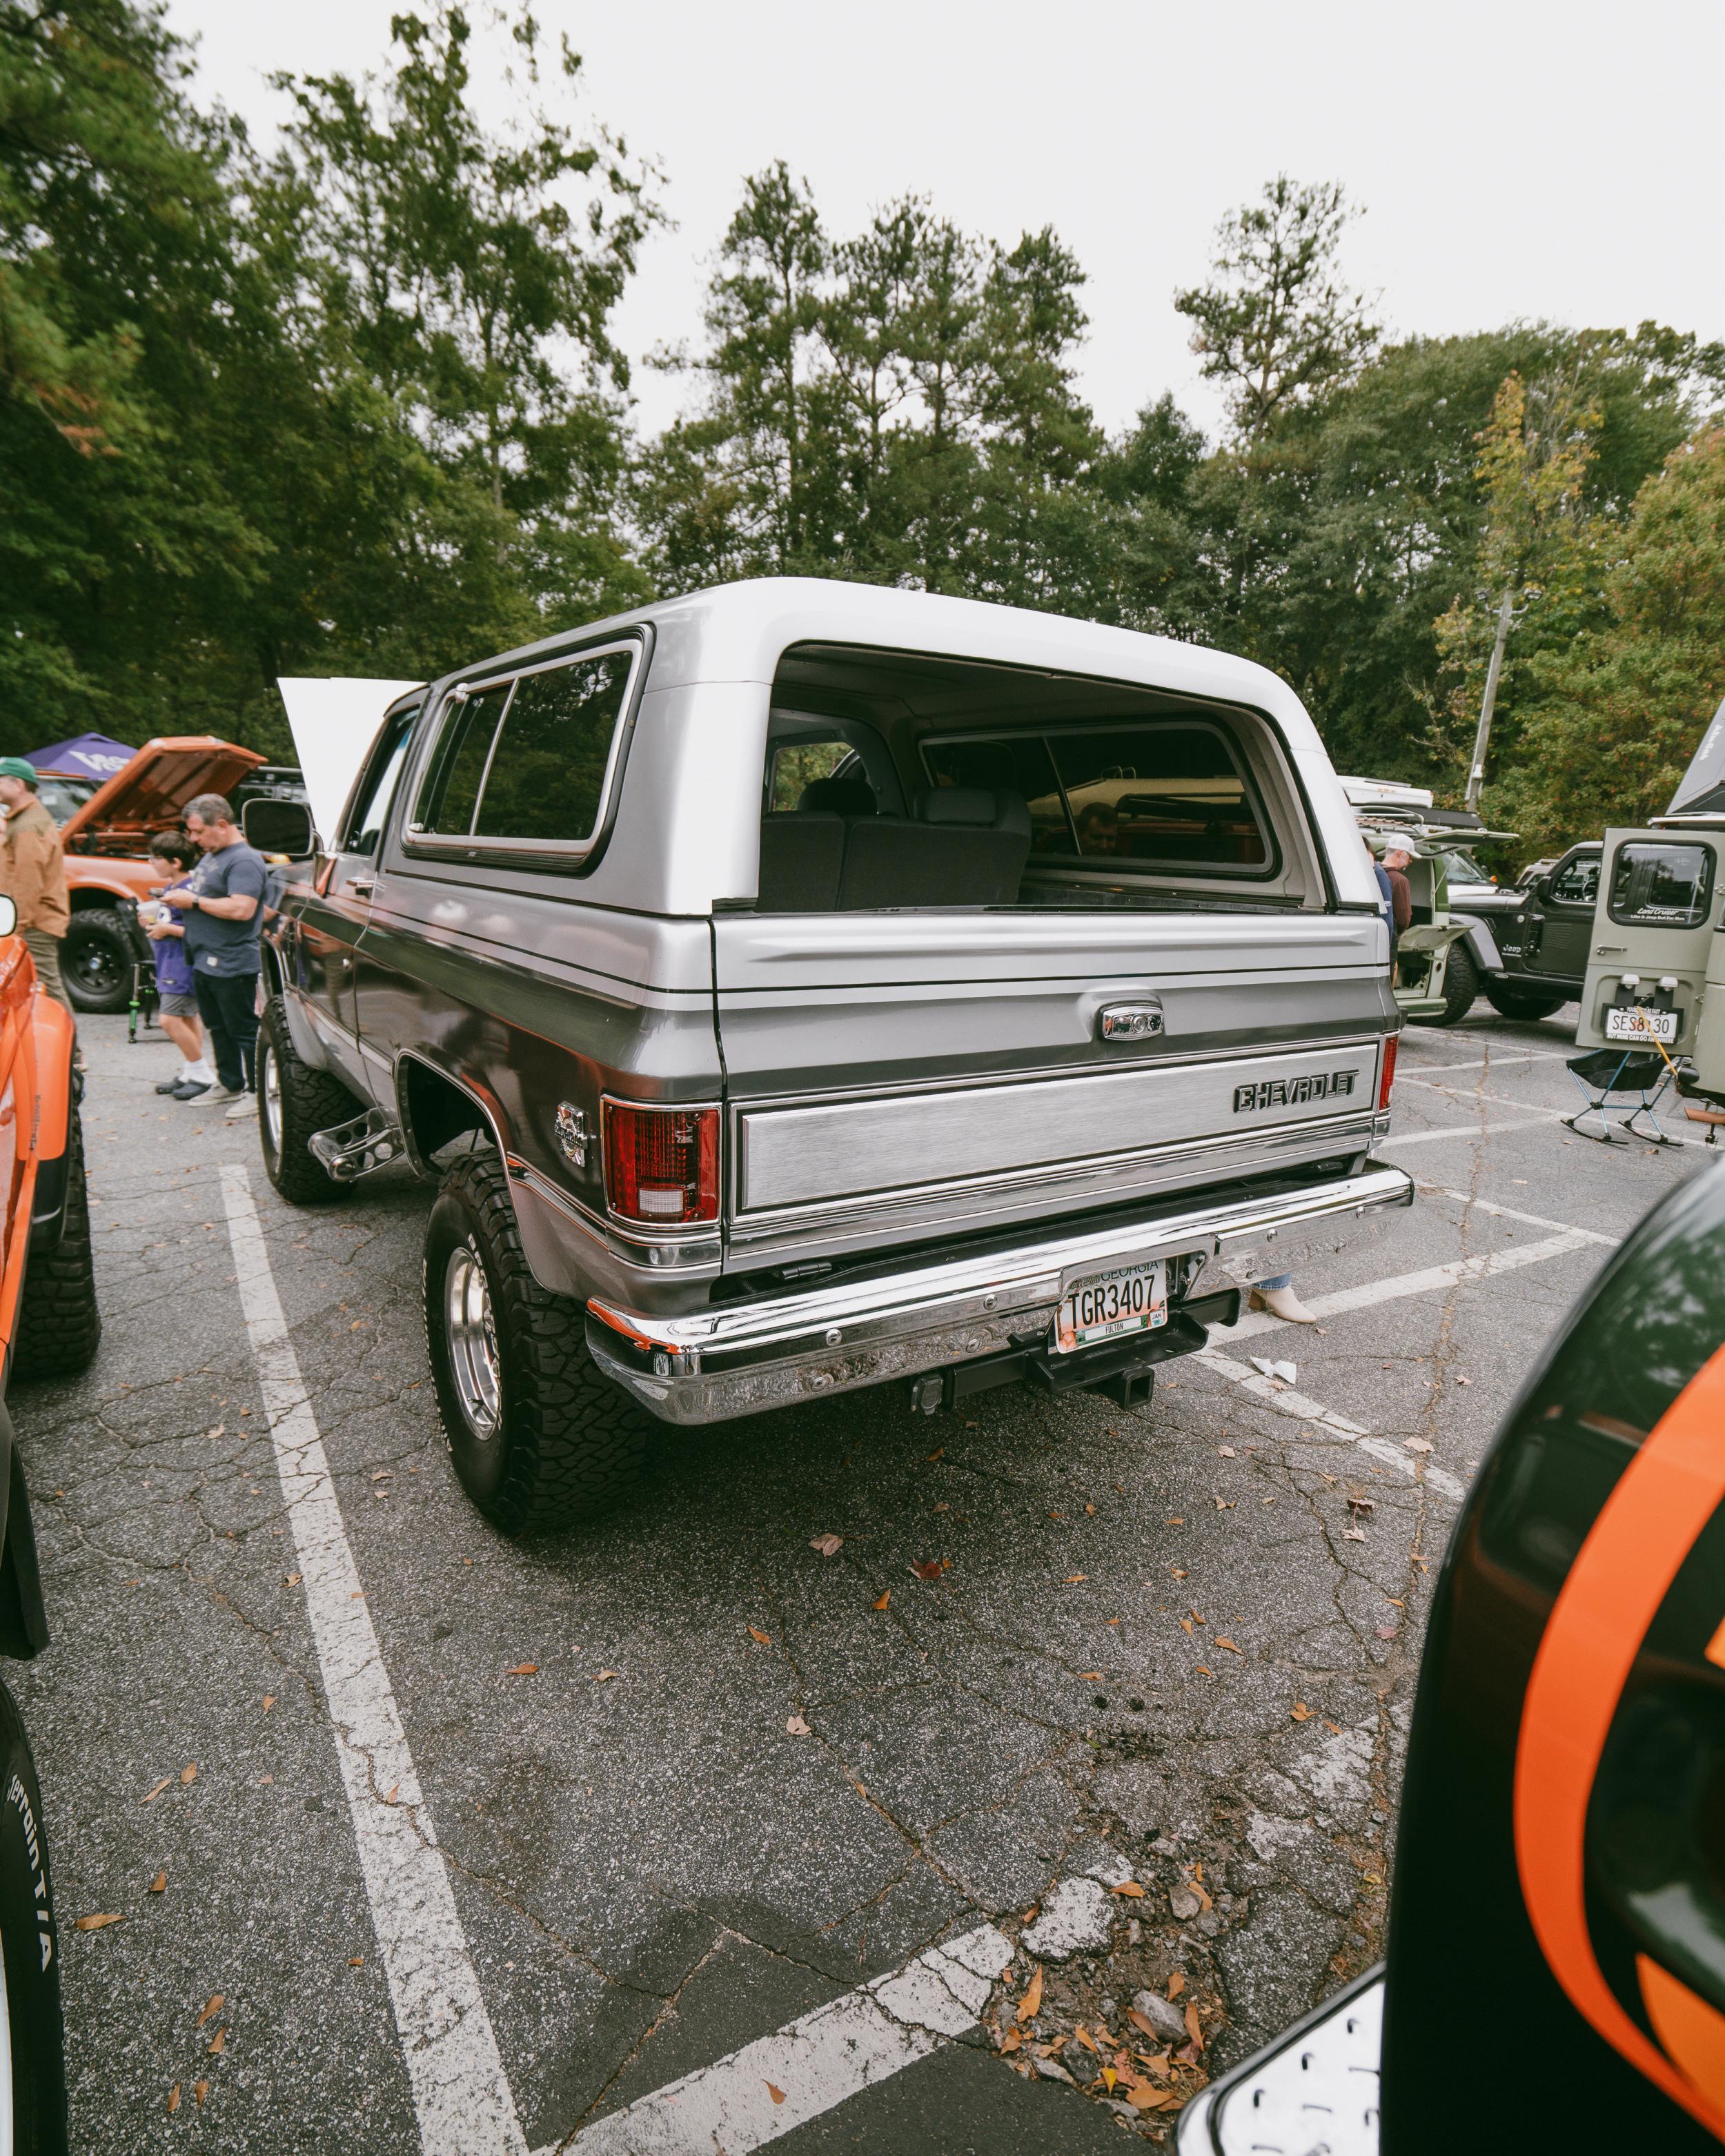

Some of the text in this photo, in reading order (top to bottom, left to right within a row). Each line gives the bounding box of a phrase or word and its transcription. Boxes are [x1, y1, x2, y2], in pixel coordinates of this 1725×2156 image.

[1503, 944, 1521, 953] Jeep
[1233, 1069, 1360, 1113] CHEVROLET
[1068, 1274, 1155, 1329] TGR3407
[1105, 1322, 1123, 1334] FULTON
